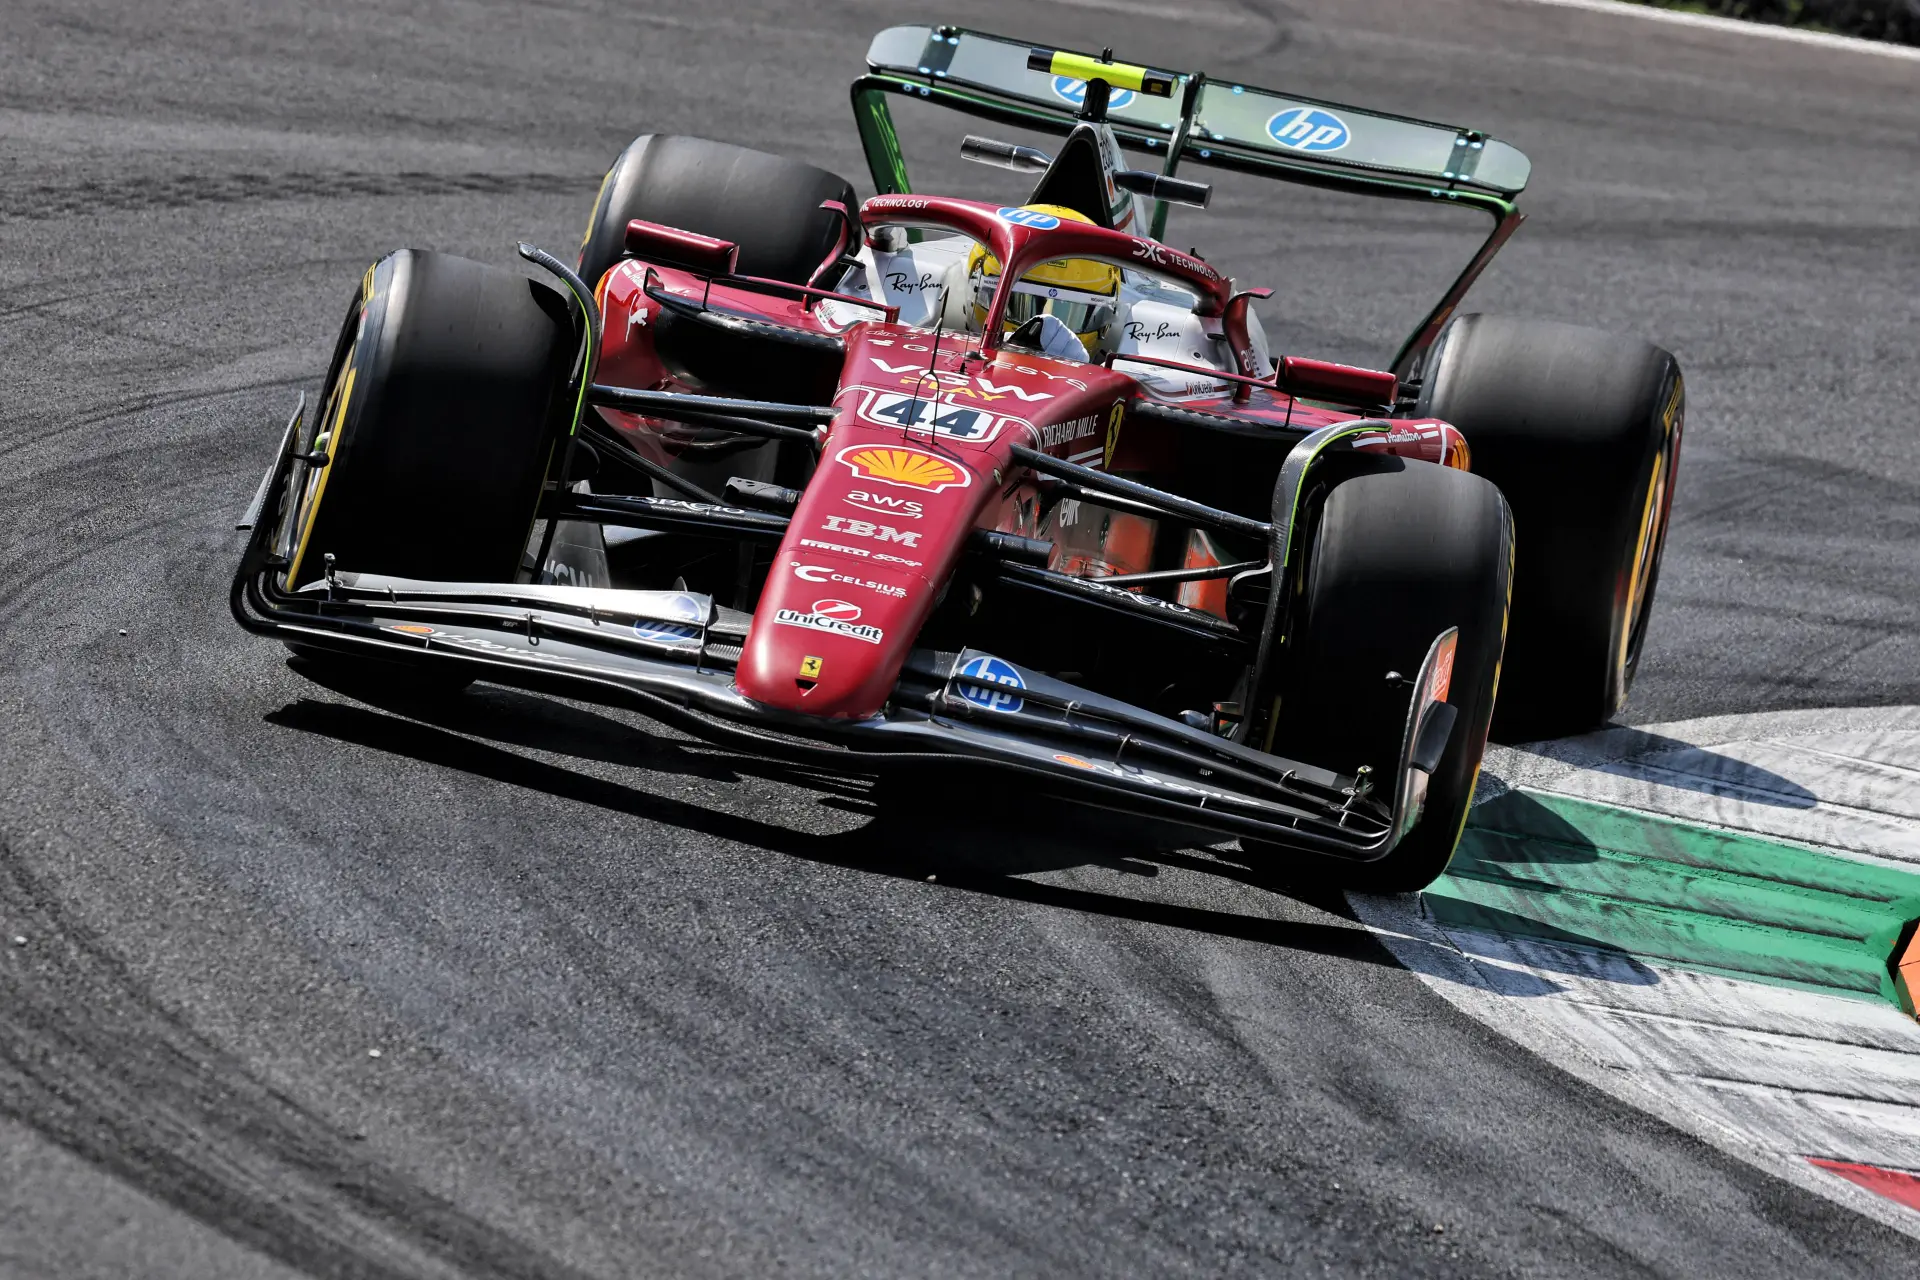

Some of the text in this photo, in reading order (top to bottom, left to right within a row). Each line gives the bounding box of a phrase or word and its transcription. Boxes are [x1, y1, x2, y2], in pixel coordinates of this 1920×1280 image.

[1274, 108, 1343, 150] hp
[871, 198, 930, 209] TECHNOLOGY
[1132, 239, 1167, 265] DXC
[885, 273, 943, 294] Ray-Ban
[1123, 321, 1182, 343] Ray-Ban
[868, 357, 1055, 402] VGW
[902, 343, 1088, 392] GEESYS
[900, 375, 1006, 401] PLAY
[876, 398, 981, 437] 44
[1042, 414, 1099, 448] RICHARD MILLE
[846, 490, 923, 513] aws
[820, 515, 923, 549] IBM
[830, 574, 907, 597] CELSIUS
[778, 611, 882, 640] UniCredit
[968, 656, 1019, 711] hp
